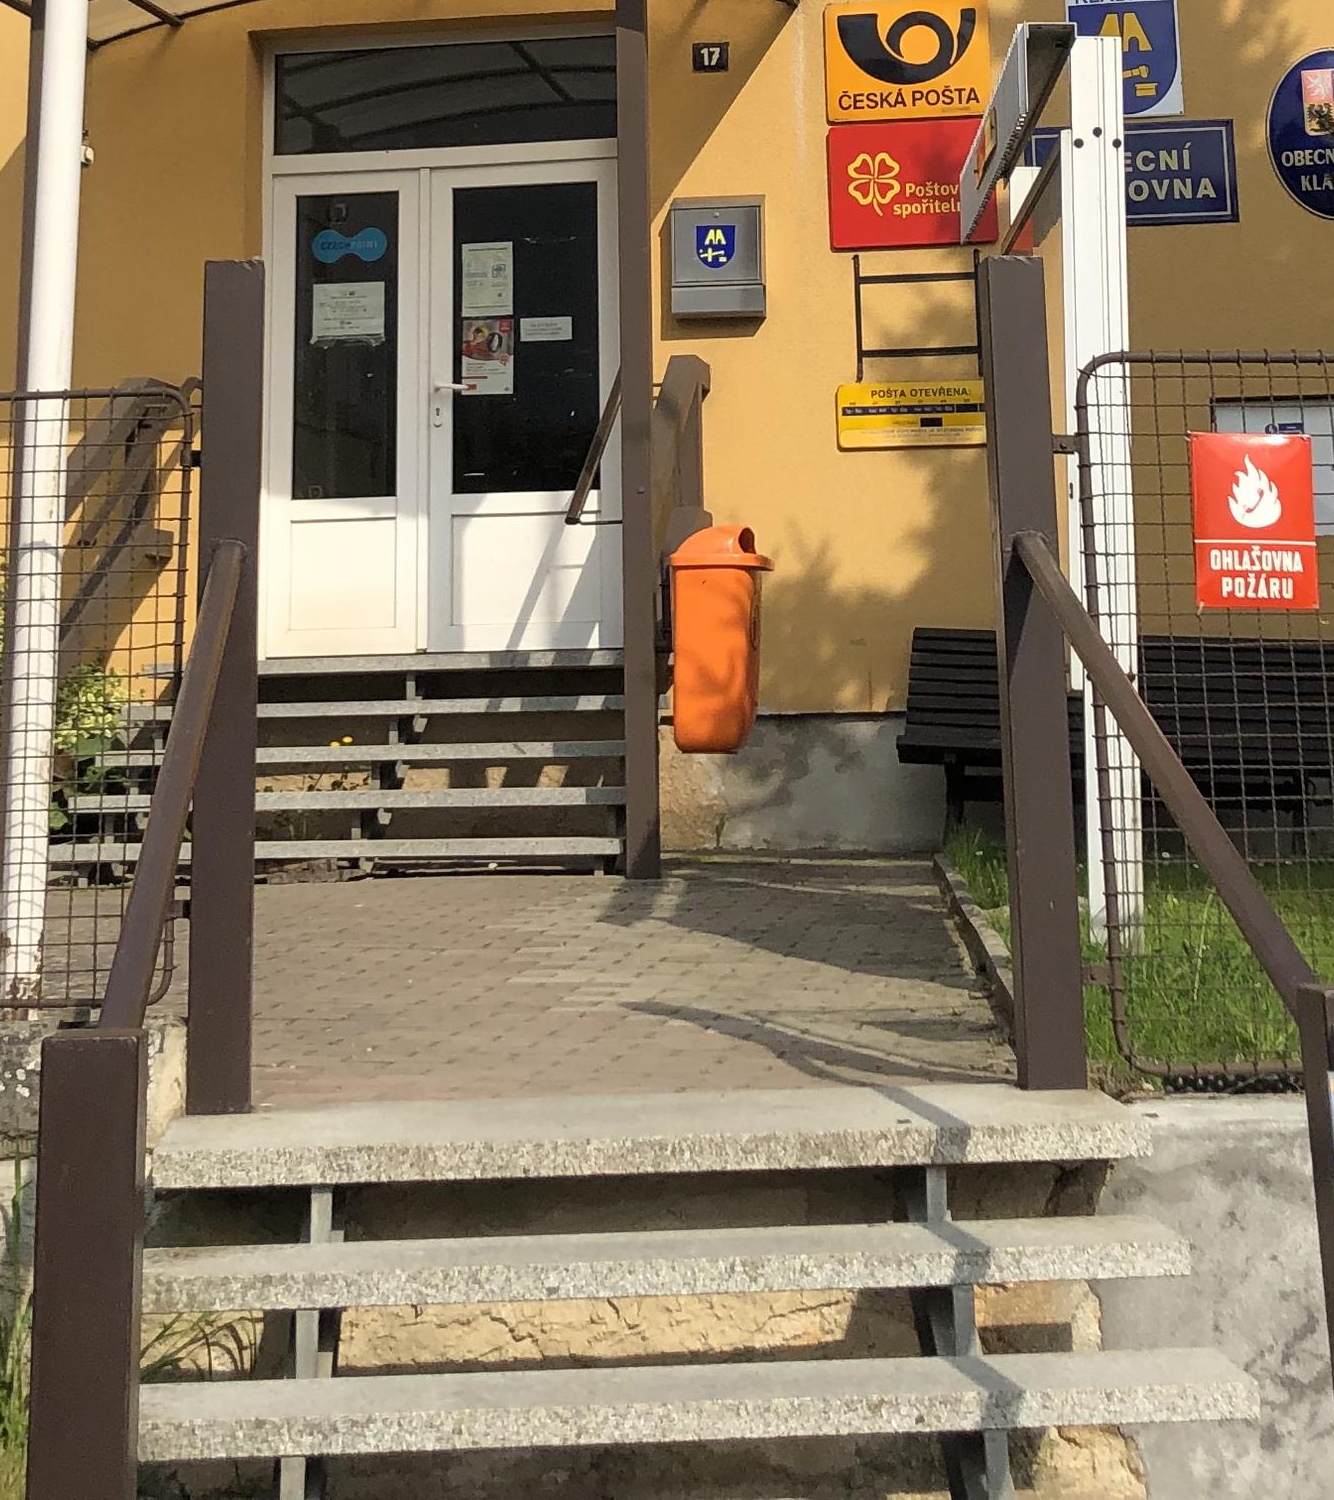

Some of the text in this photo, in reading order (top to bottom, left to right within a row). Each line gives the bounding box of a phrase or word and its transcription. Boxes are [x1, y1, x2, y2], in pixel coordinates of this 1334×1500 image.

[700, 47, 720, 66] 17
[838, 85, 980, 111] ČESKÁ POŠTA
[1124, 141, 1193, 173] ECNÍ
[905, 181, 959, 197] Poštov
[1128, 177, 1217, 202] OVNA
[893, 198, 960, 218] spořitel
[870, 387, 907, 399] POŠTA
[1210, 545, 1304, 573] OHLAŠOVNA
[1221, 572, 1294, 600] POŽÁRU
